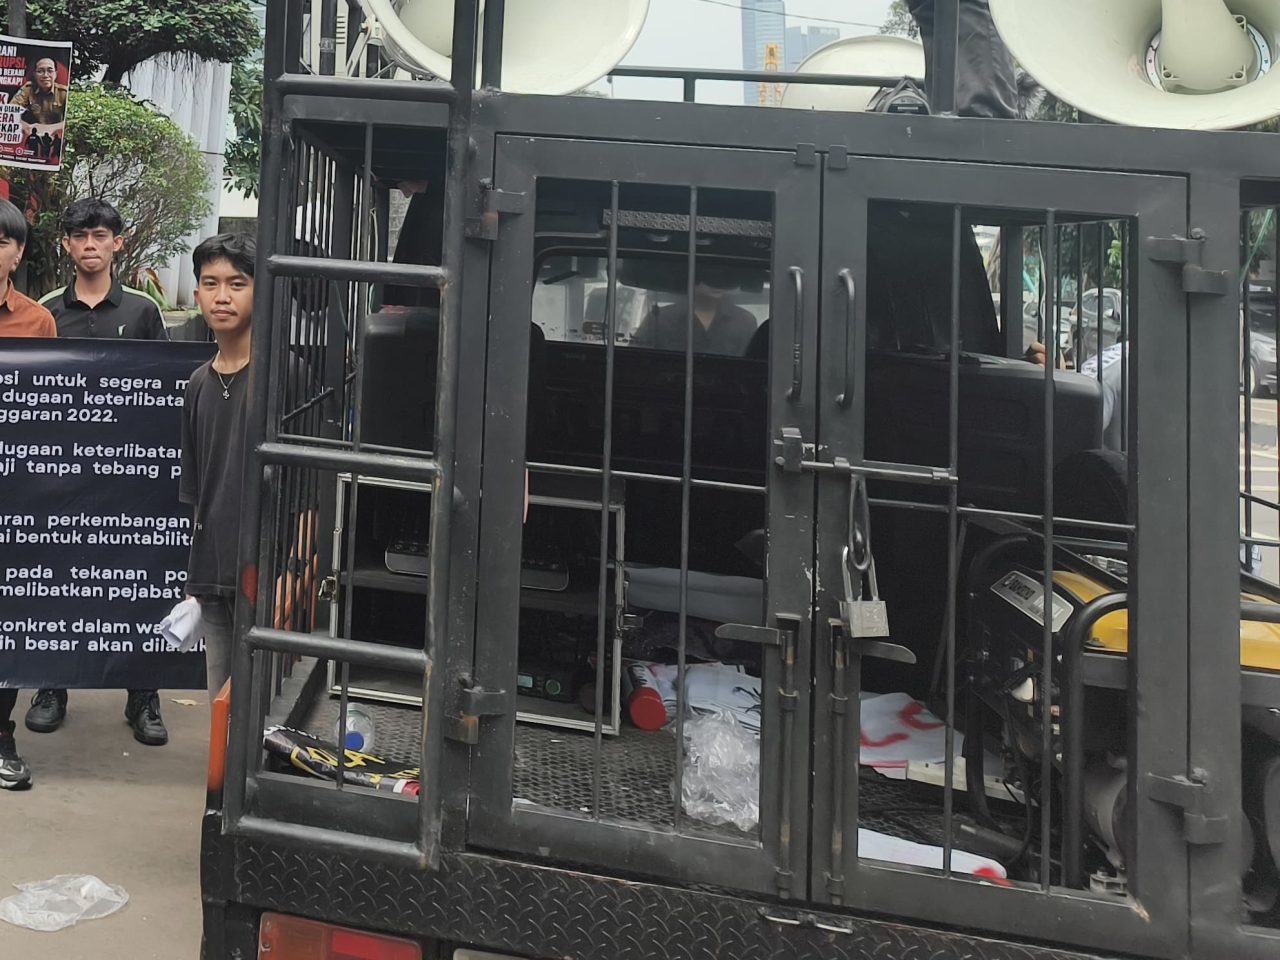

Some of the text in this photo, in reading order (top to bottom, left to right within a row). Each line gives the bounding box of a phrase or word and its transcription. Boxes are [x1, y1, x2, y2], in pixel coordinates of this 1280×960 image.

[4, 68, 24, 76] BERANI
[33, 373, 86, 387] untuk
[100, 378, 161, 391] segera
[3, 389, 72, 406] dugaan
[83, 392, 184, 407] keterlibata
[67, 409, 117, 422] 2022.
[27, 461, 81, 476] tanpa
[93, 461, 159, 478] tebang
[48, 513, 189, 530] perkembangan
[16, 530, 82, 543] bentuk
[6, 565, 52, 581] pada
[70, 566, 147, 580] tekanan
[109, 583, 180, 601] pejabat
[72, 619, 130, 633] dalam
[26, 636, 78, 650] besar
[88, 637, 133, 651] akan
